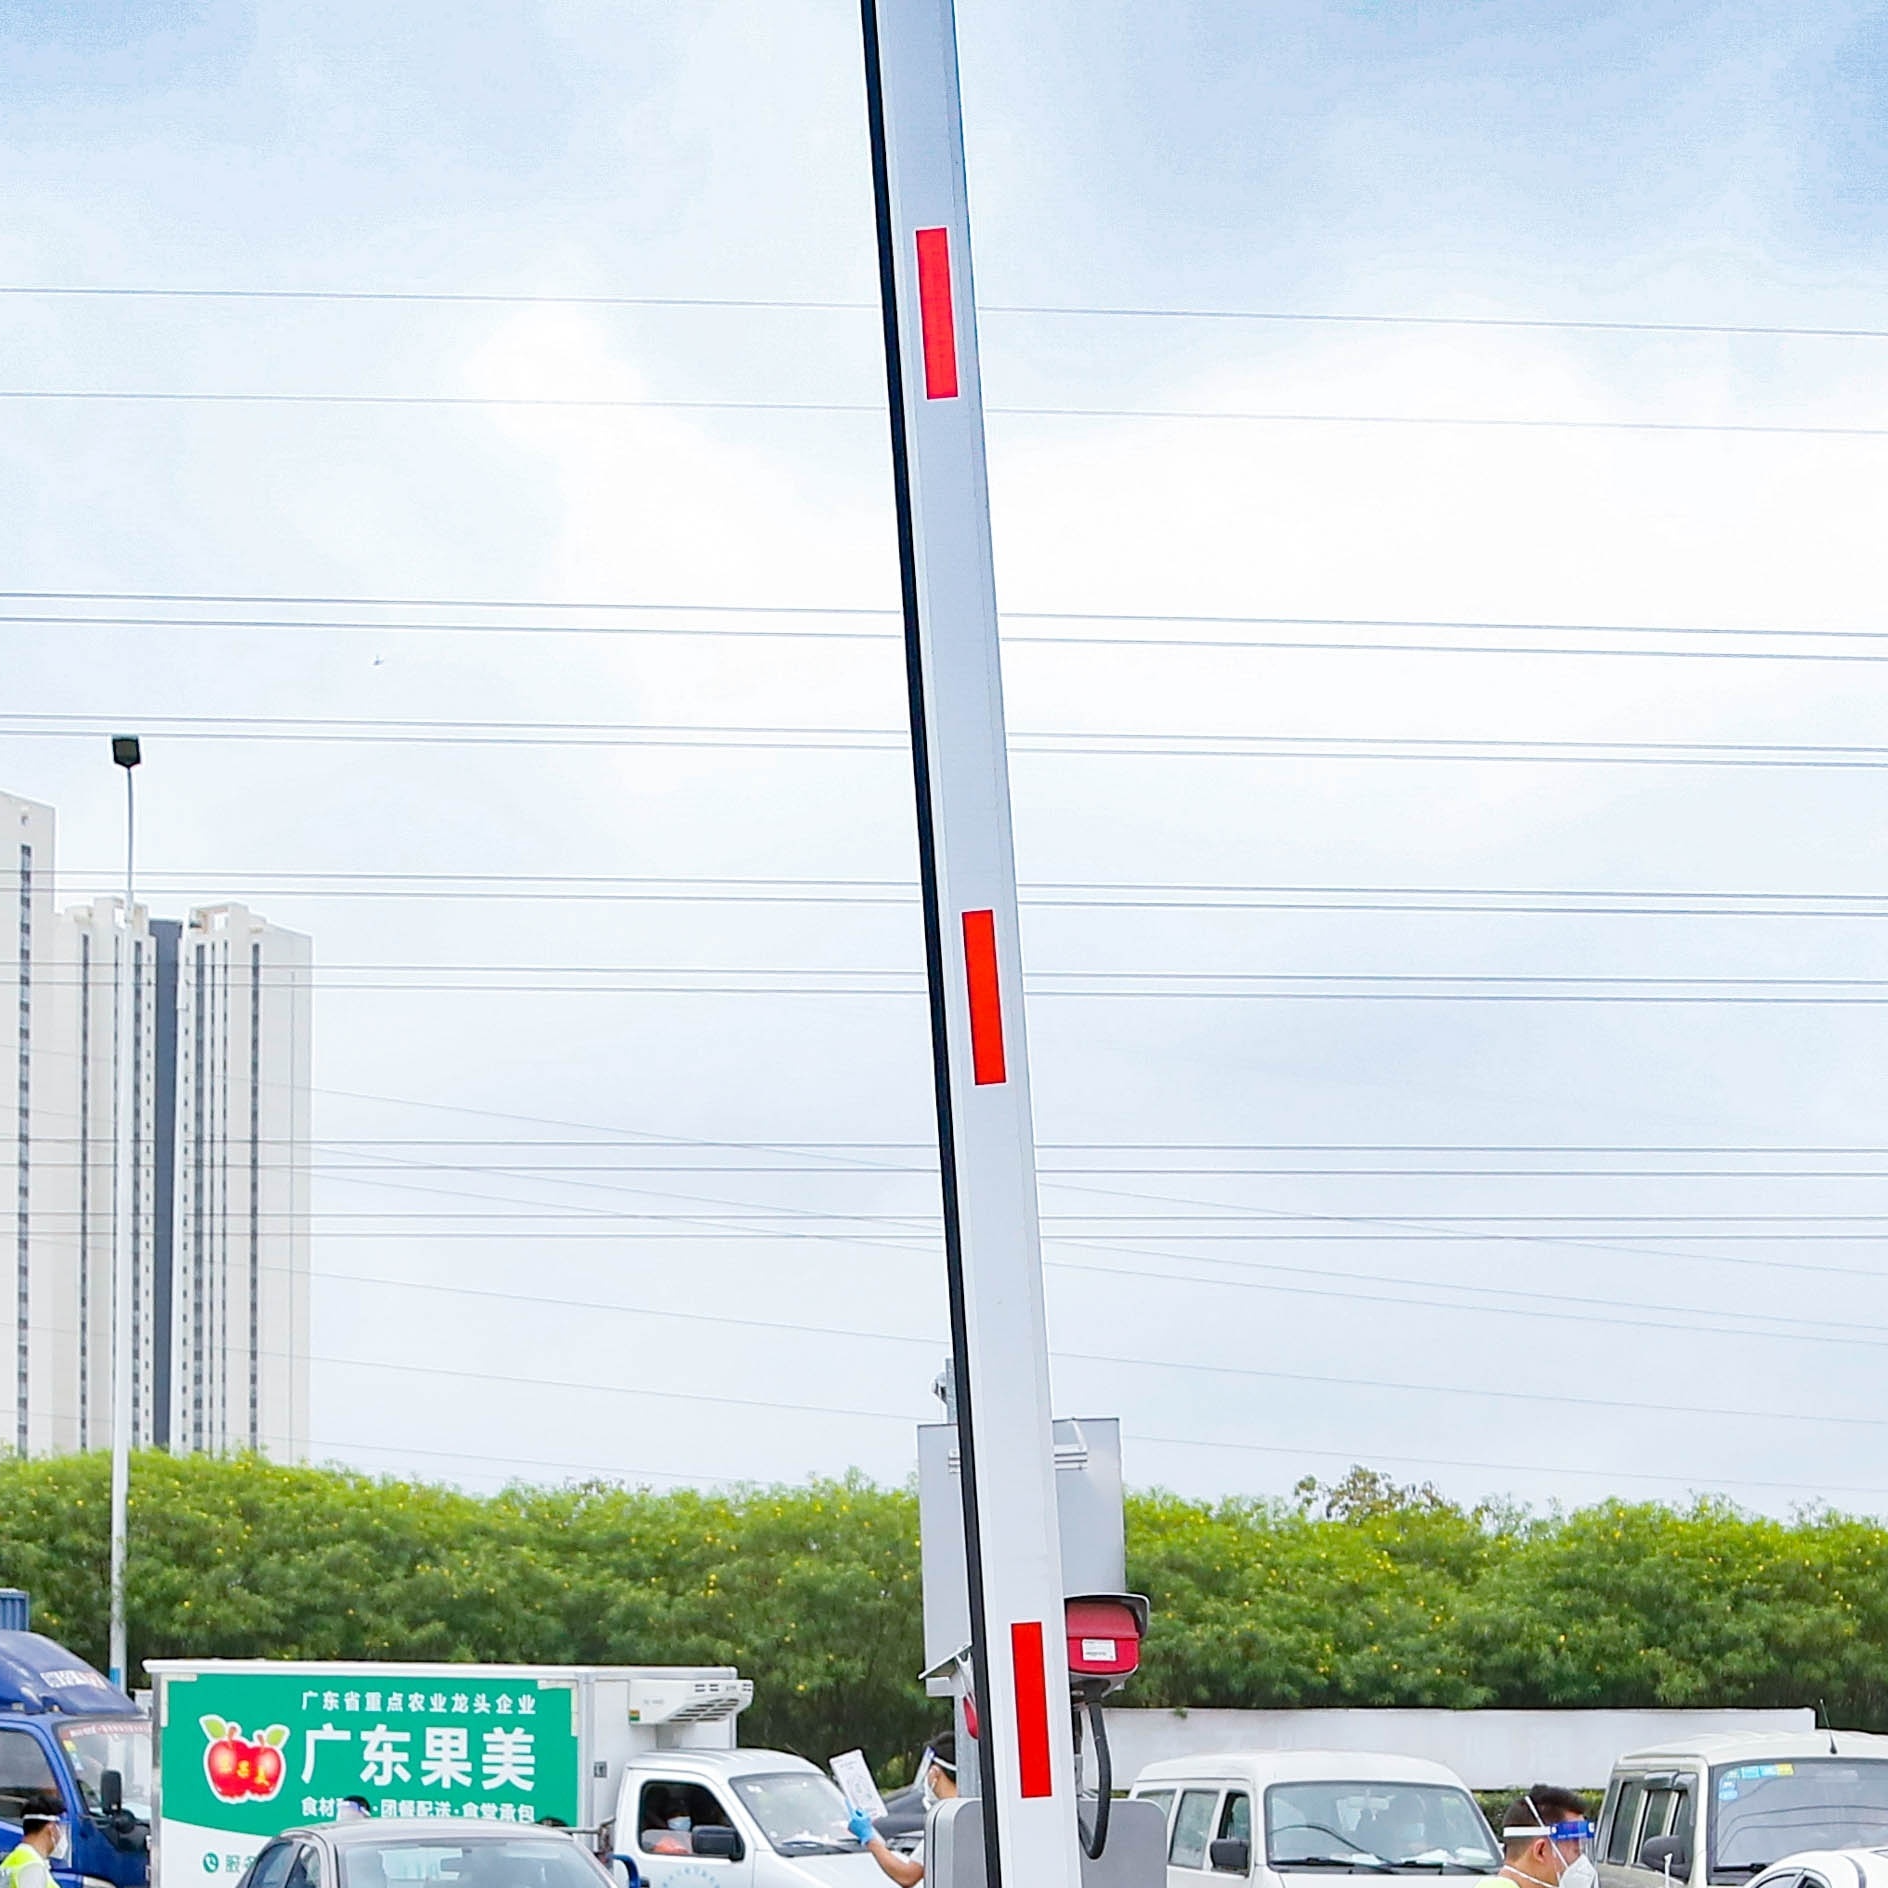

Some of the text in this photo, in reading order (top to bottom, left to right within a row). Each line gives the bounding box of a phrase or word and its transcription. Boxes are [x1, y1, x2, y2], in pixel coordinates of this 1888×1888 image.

[301, 1690, 536, 1715] 广东省重点农业龙头企业
[301, 1722, 536, 1792] 广东果美
